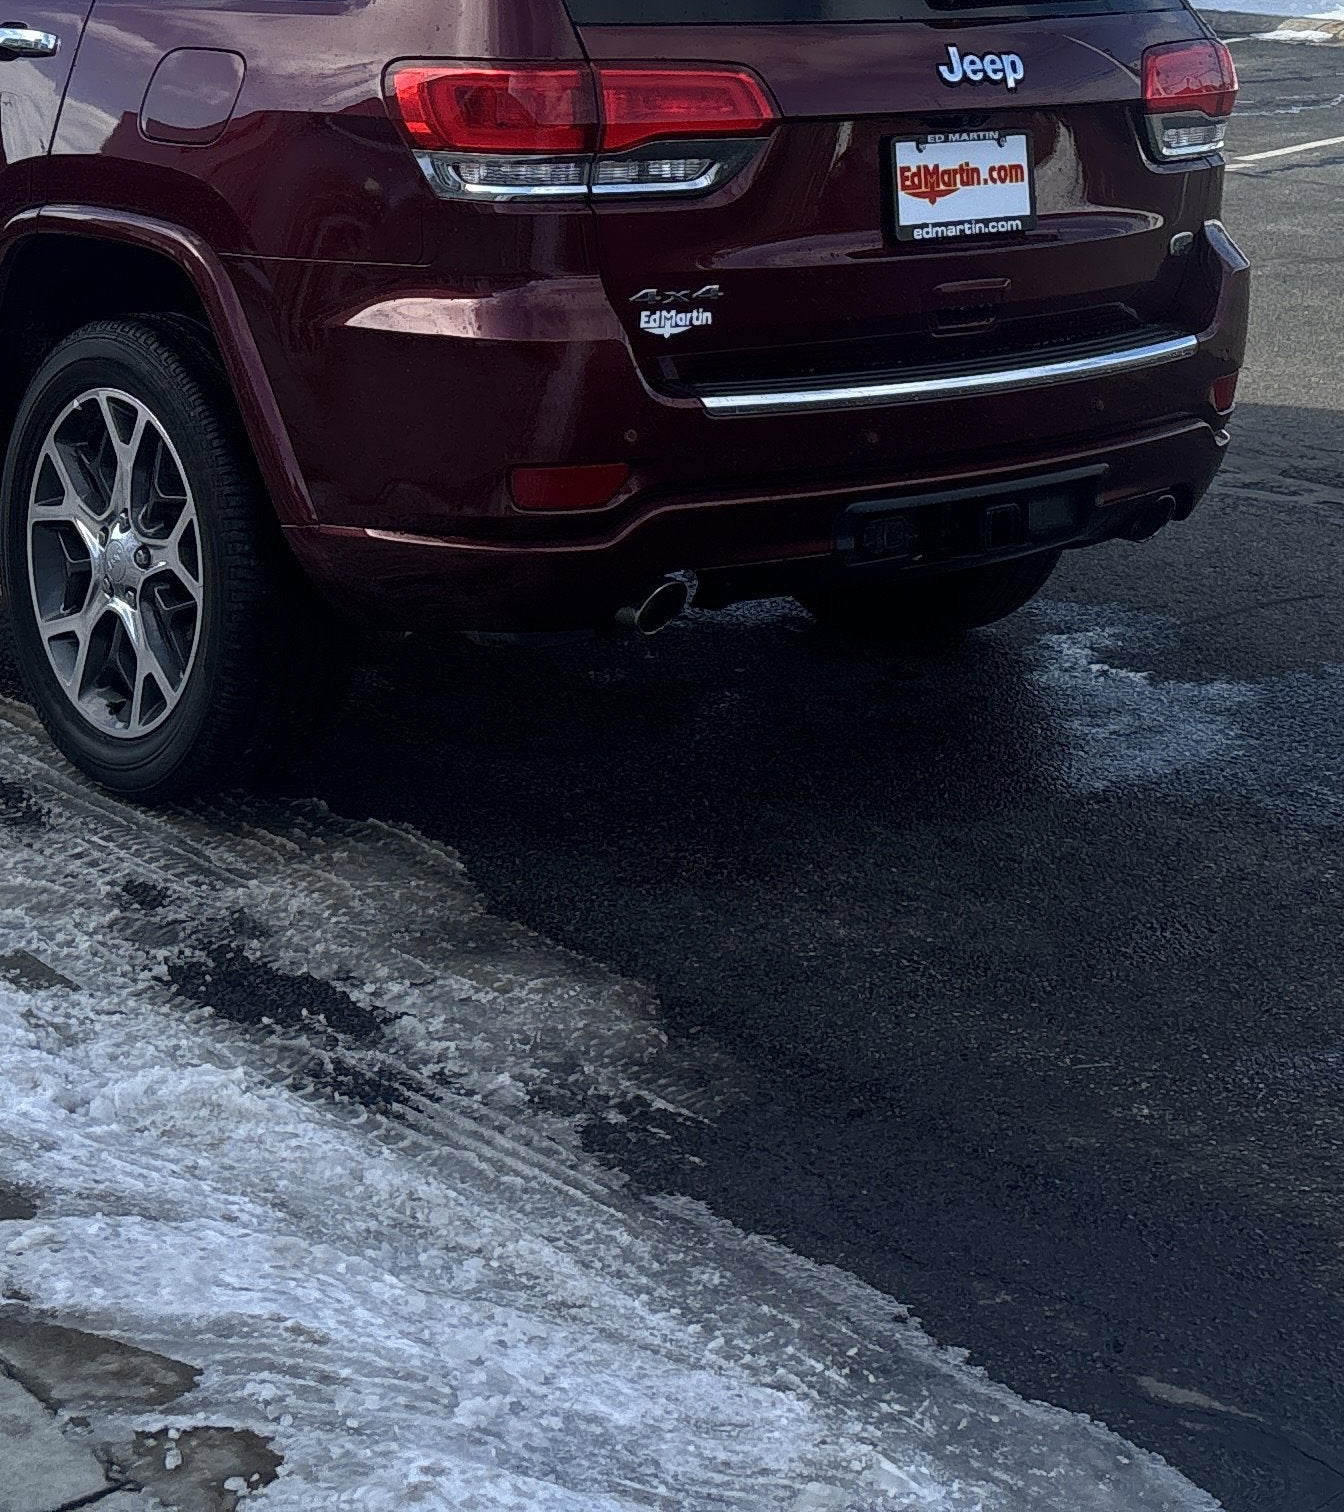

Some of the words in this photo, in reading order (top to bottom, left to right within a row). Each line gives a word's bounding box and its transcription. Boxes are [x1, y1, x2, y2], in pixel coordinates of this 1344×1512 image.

[938, 46, 1025, 89] Jeep
[927, 133, 945, 143] ED
[948, 130, 999, 142] MARTIN
[898, 161, 1025, 191] EdMartin.com
[913, 219, 1022, 240] edmartin.com
[640, 308, 712, 329] EdMartin
